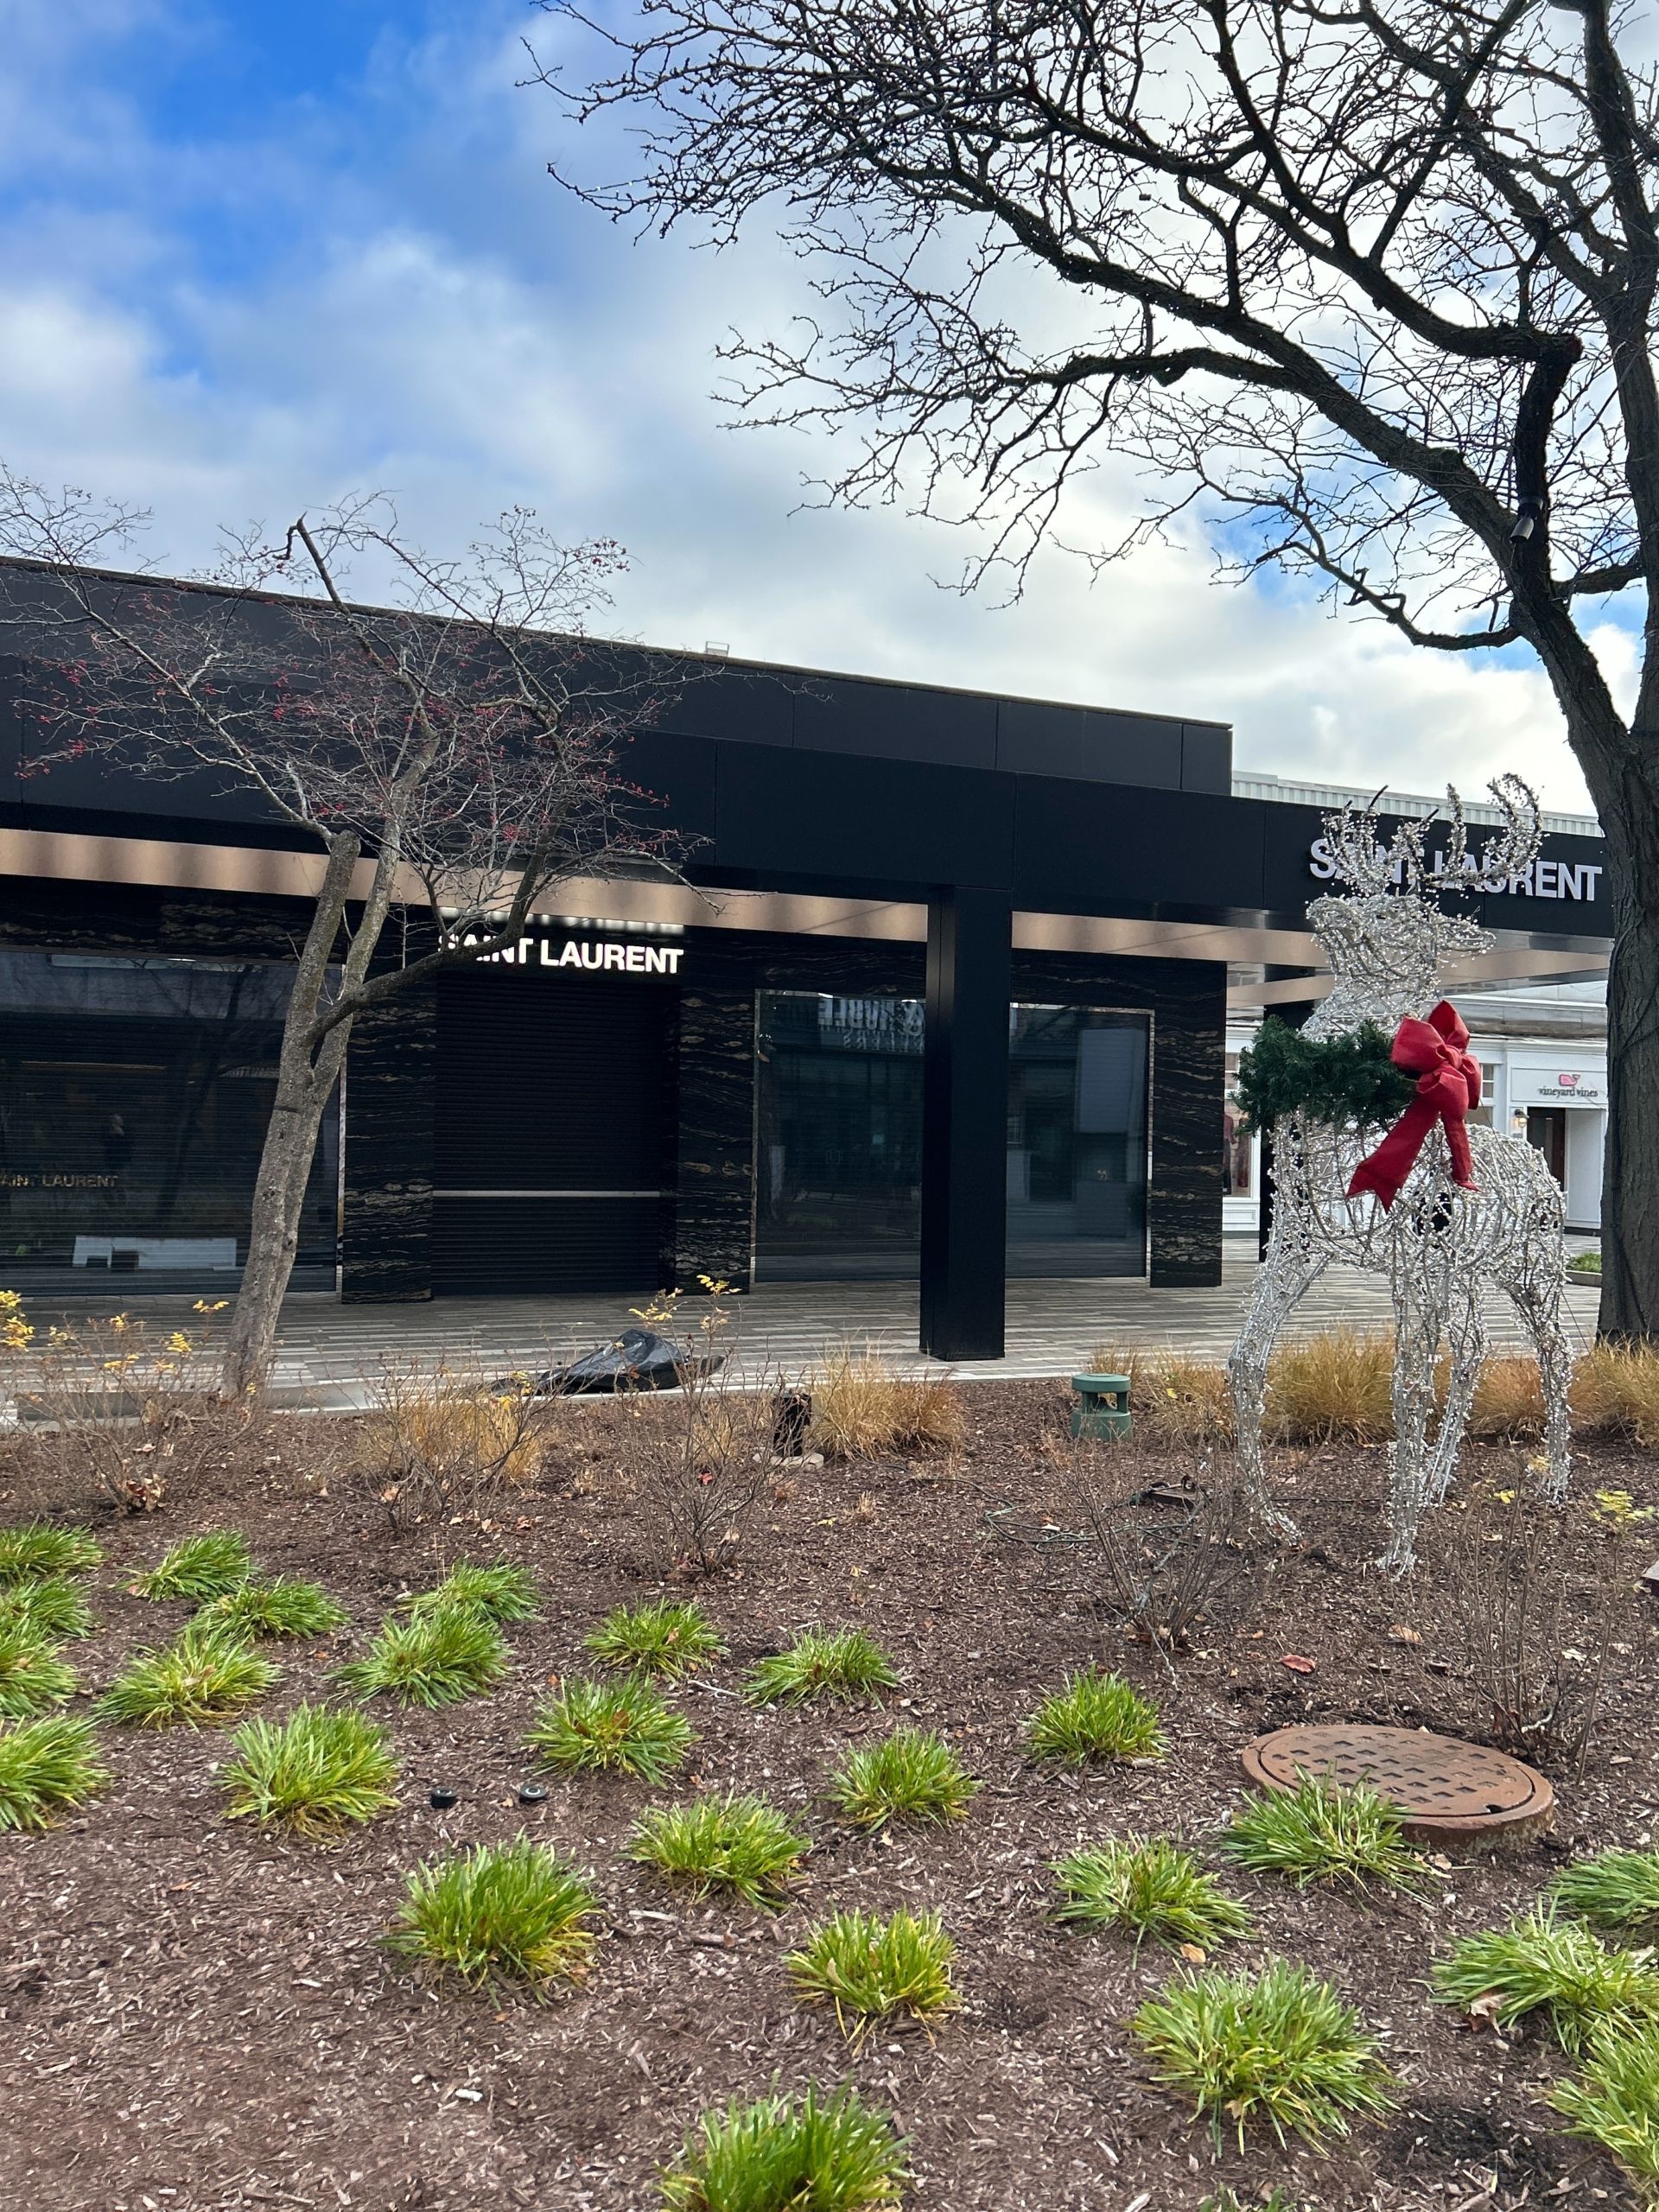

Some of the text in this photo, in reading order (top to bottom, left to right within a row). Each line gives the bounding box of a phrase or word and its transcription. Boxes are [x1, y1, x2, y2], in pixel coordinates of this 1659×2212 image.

[1309, 838, 1426, 885] SNT
[540, 939, 684, 974] LAURENT
[1538, 1086, 1599, 1098] vineyard vines
[41, 1174, 118, 1187] LAURENT
